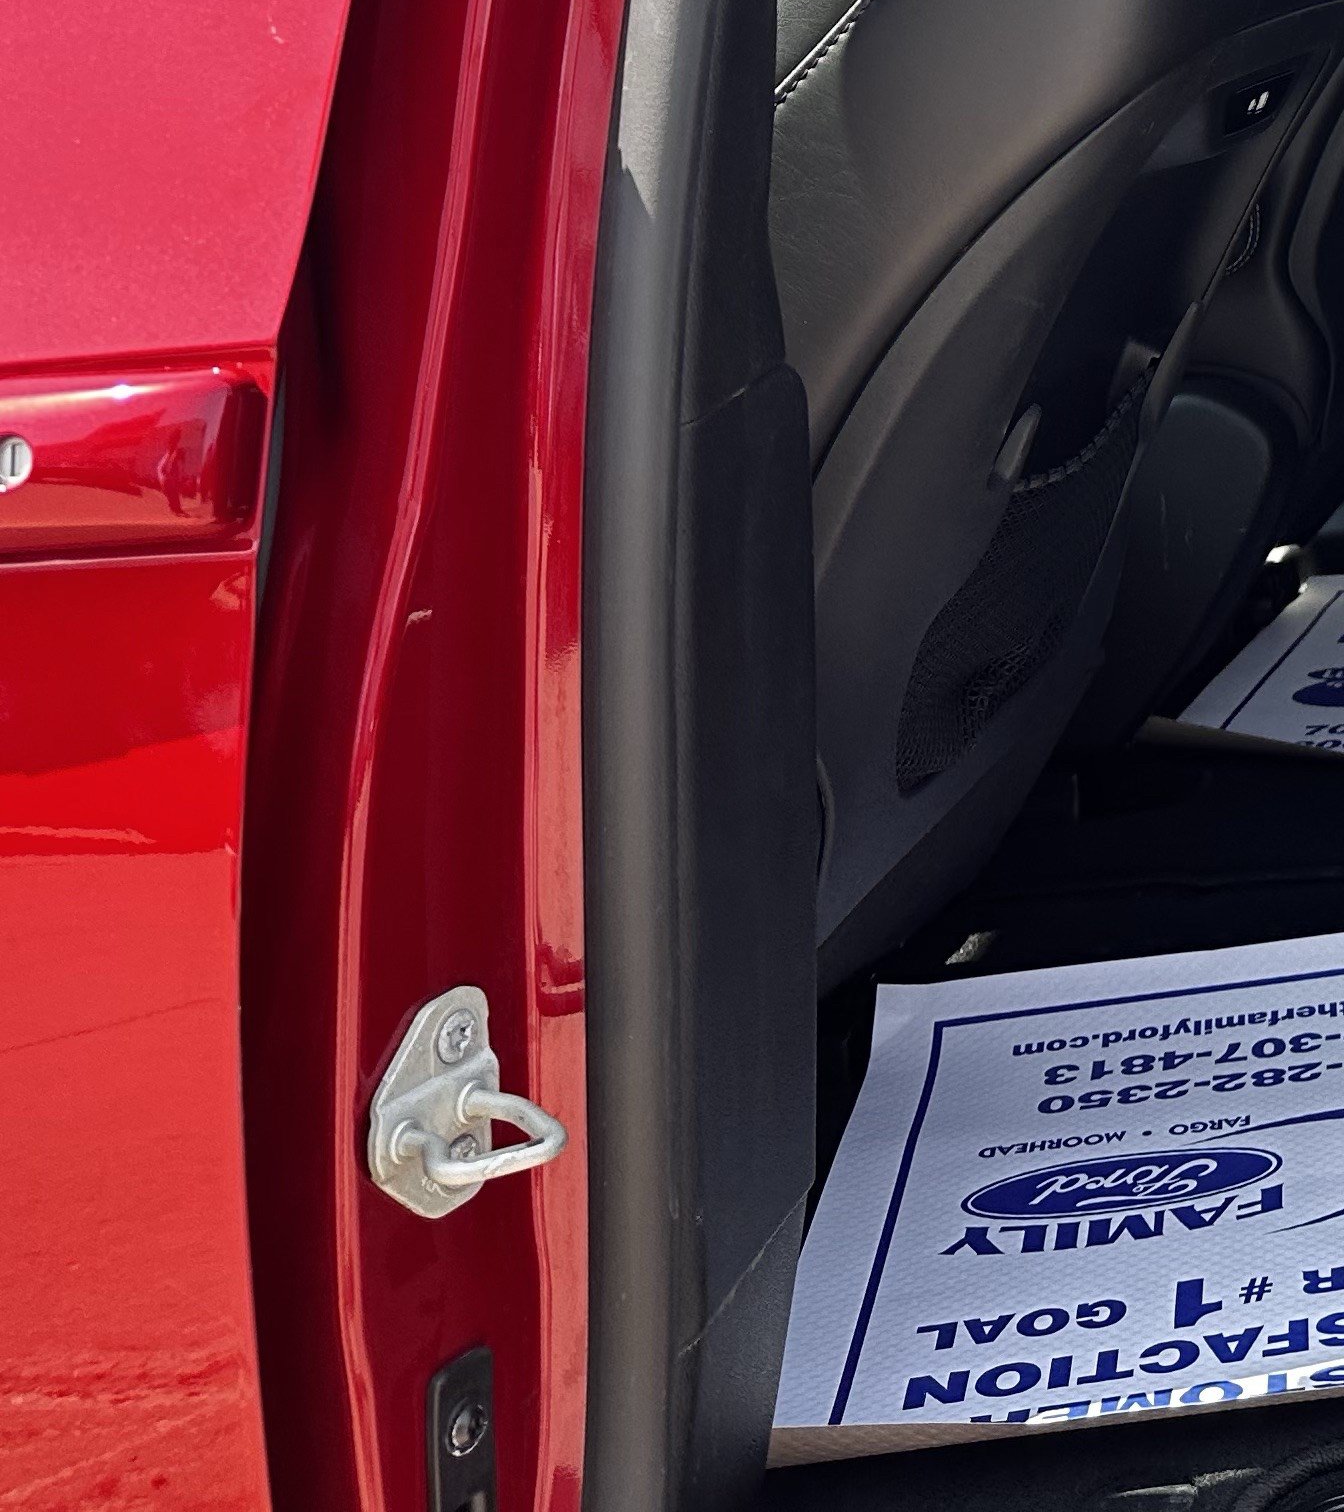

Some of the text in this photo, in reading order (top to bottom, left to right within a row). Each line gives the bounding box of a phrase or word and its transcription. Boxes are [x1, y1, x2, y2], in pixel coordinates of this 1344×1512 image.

[977, 1114, 1251, 1159] FARGO MOORHEAD
[1027, 1157, 1218, 1208] Ford
[937, 1183, 1285, 1256] FAMILY
[915, 1298, 1128, 1351] GOAL
